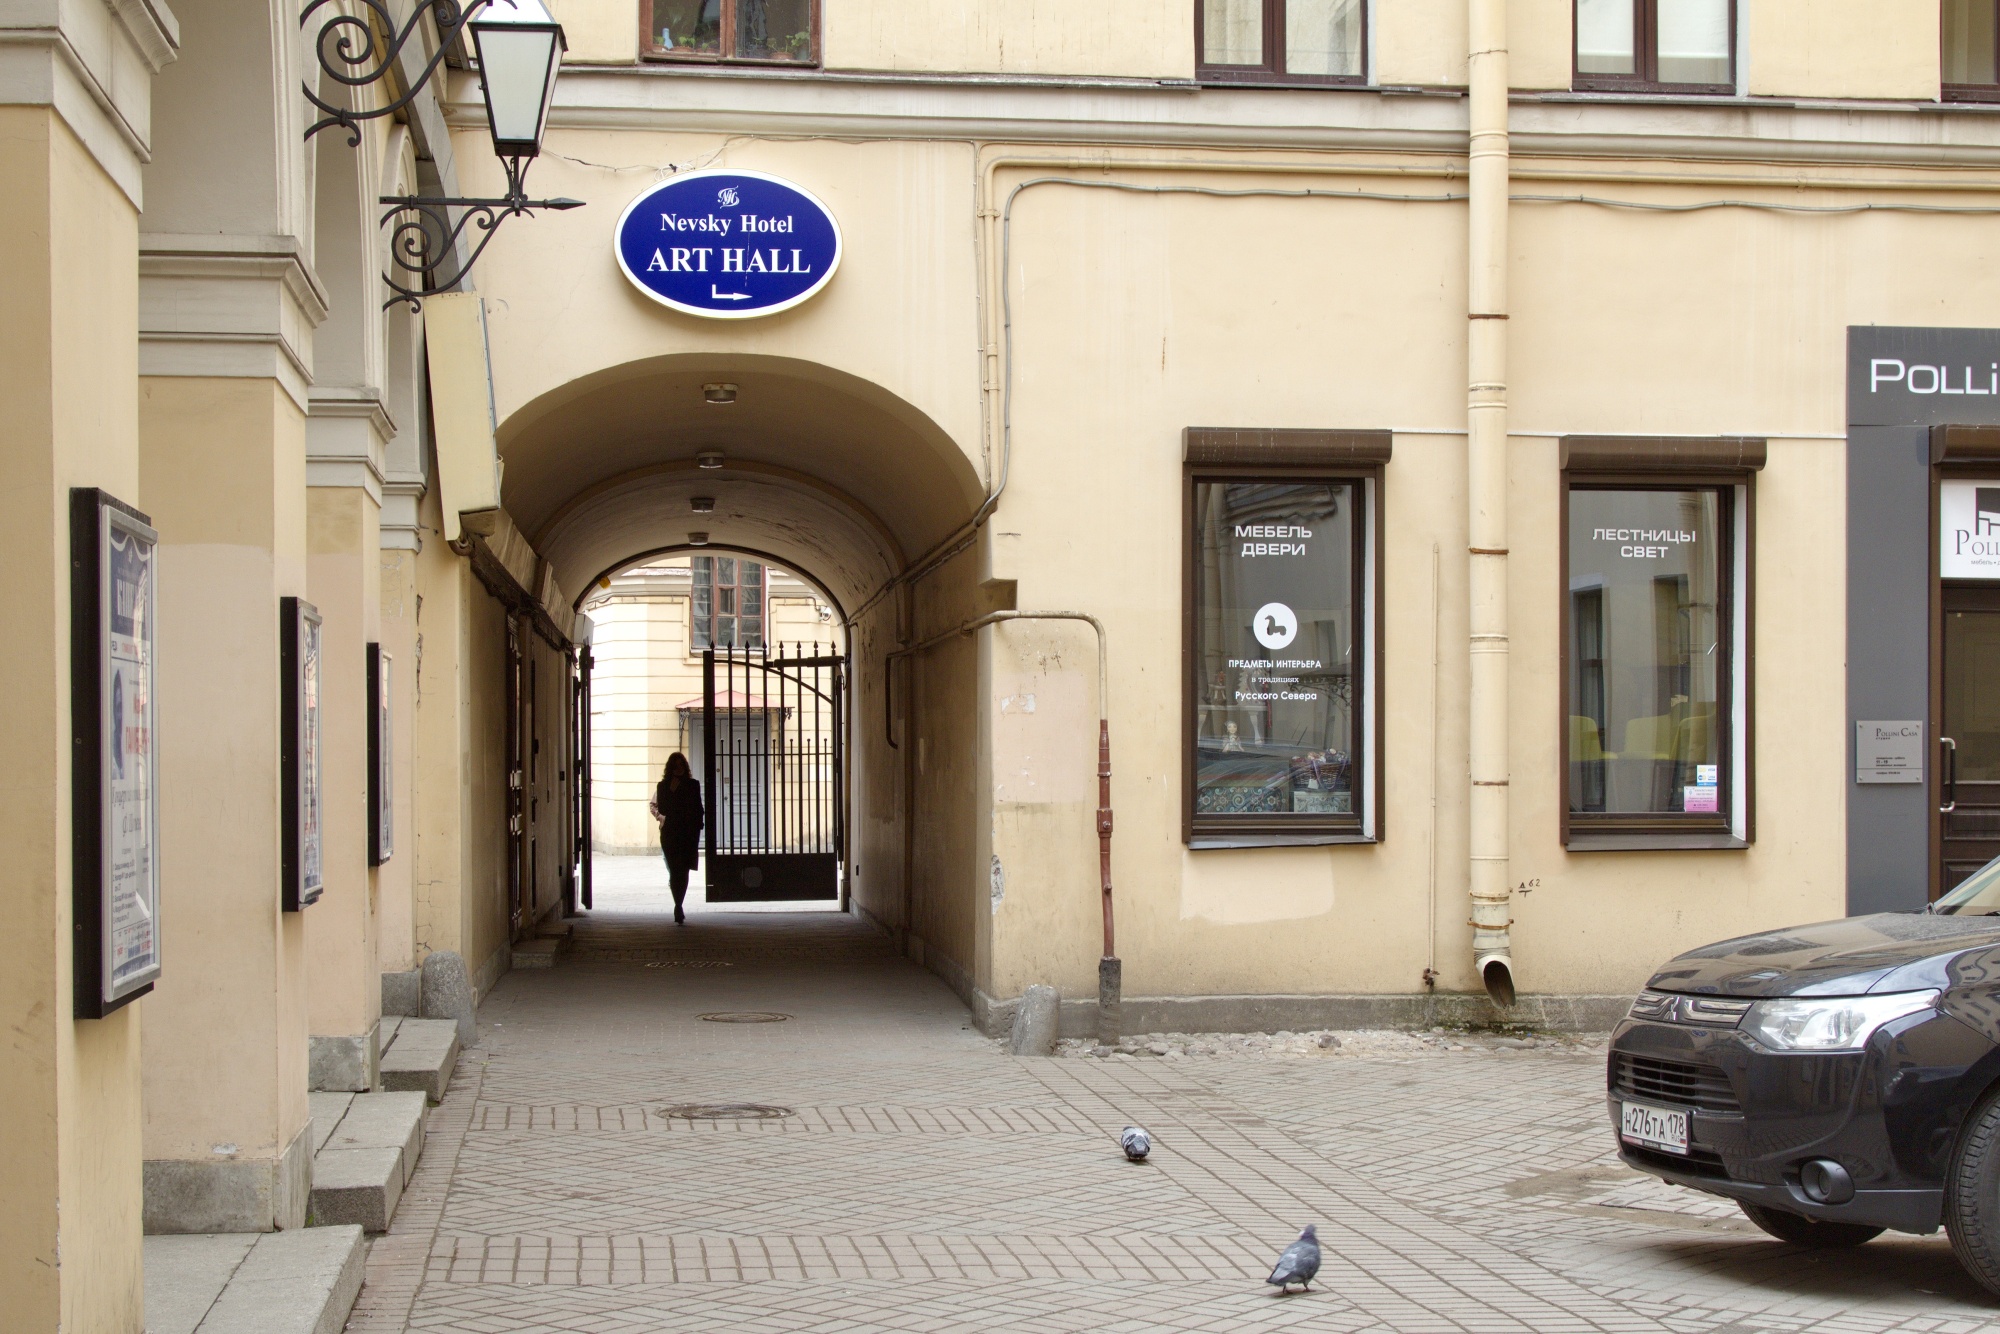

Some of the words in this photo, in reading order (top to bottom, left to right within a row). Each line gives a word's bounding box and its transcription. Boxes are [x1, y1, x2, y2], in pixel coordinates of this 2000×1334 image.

[660, 213, 731, 236] Nevsky
[740, 214, 793, 233] Hotel
[646, 247, 713, 272] ART
[720, 248, 811, 274] HALL
[1235, 525, 1312, 538] МЕБЕЛЬ
[1592, 528, 1696, 545] ЛЕСТНИЦЫ
[1241, 543, 1306, 558] ДВЕРИ
[1620, 545, 1669, 558] СВЕТ
[1228, 659, 1274, 669] ПРЕДМЕТЫ
[1276, 660, 1322, 669] ИНТЕРЬЕРА
[1258, 677, 1299, 685] традициях
[1235, 691, 1278, 702] Русского
[1280, 691, 1317, 702] Севера
[1667, 1113, 1685, 1136] 178
